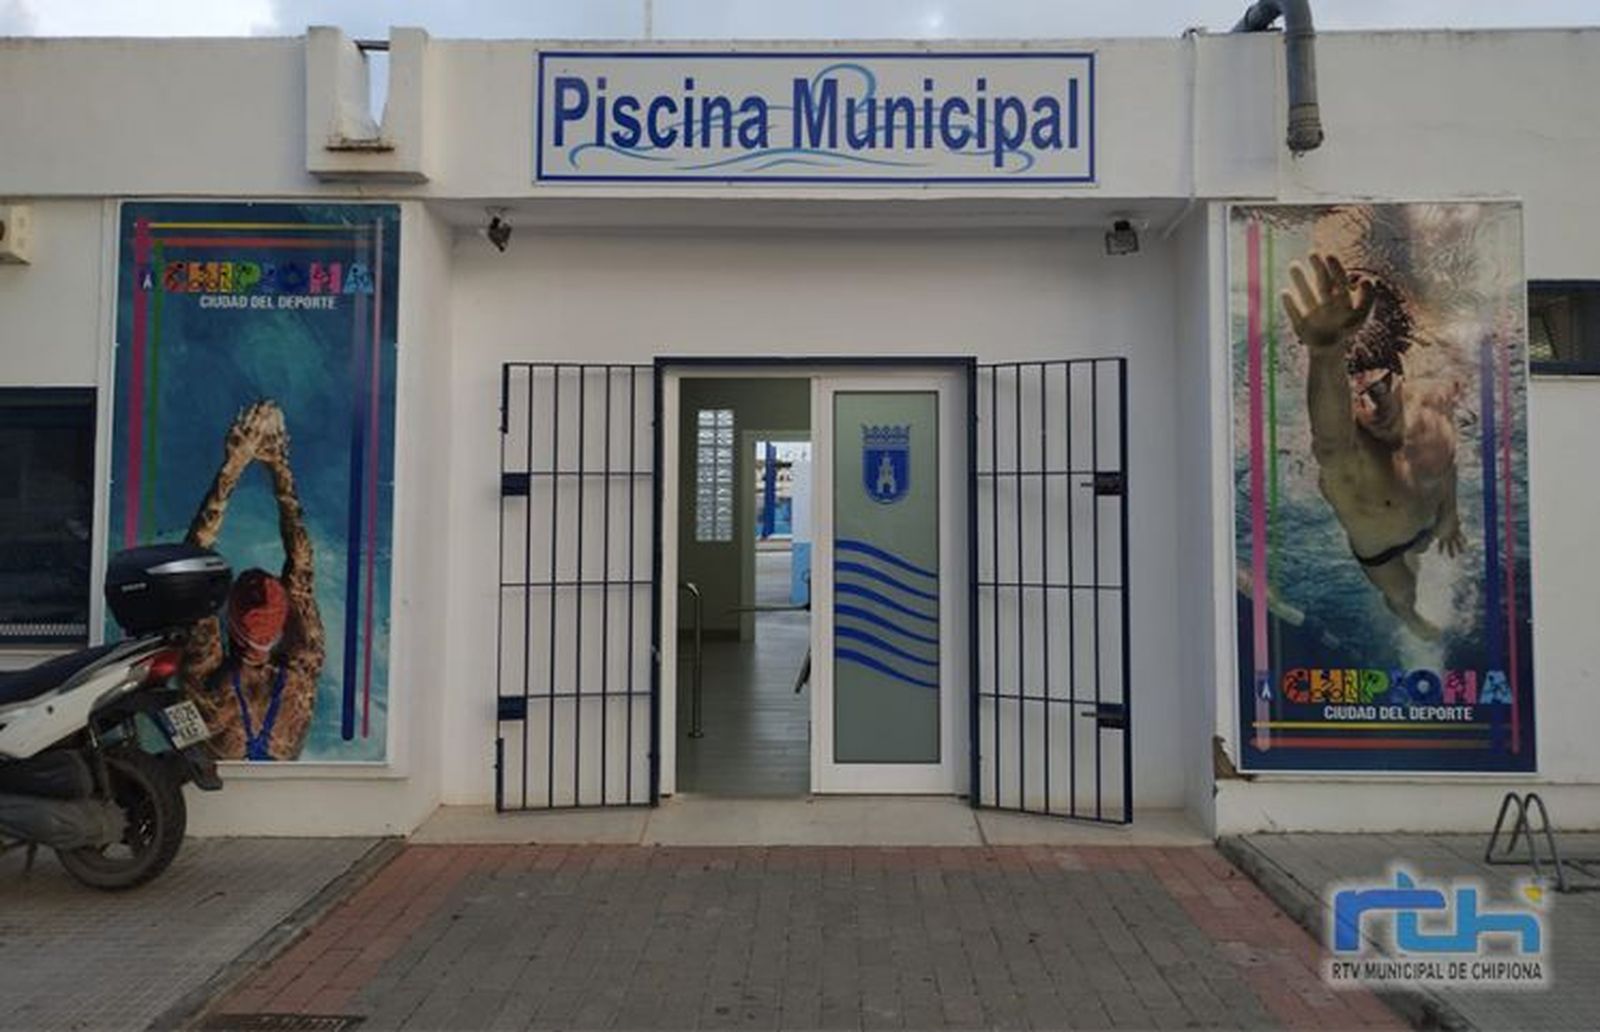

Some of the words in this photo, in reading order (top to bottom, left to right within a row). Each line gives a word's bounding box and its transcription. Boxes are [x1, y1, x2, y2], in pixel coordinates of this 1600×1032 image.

[553, 76, 768, 148] Piscina
[793, 77, 1079, 168] Municipal
[163, 261, 374, 294] CHIPIONA
[200, 295, 247, 309] CIUDAD
[250, 296, 275, 309] DEL
[278, 296, 336, 310] DEPORTE
[1282, 669, 1513, 705] CHIPIONA
[1324, 704, 1376, 720] CIUDAD
[1379, 705, 1405, 720] DEL
[1410, 706, 1473, 721] DEPORTE
